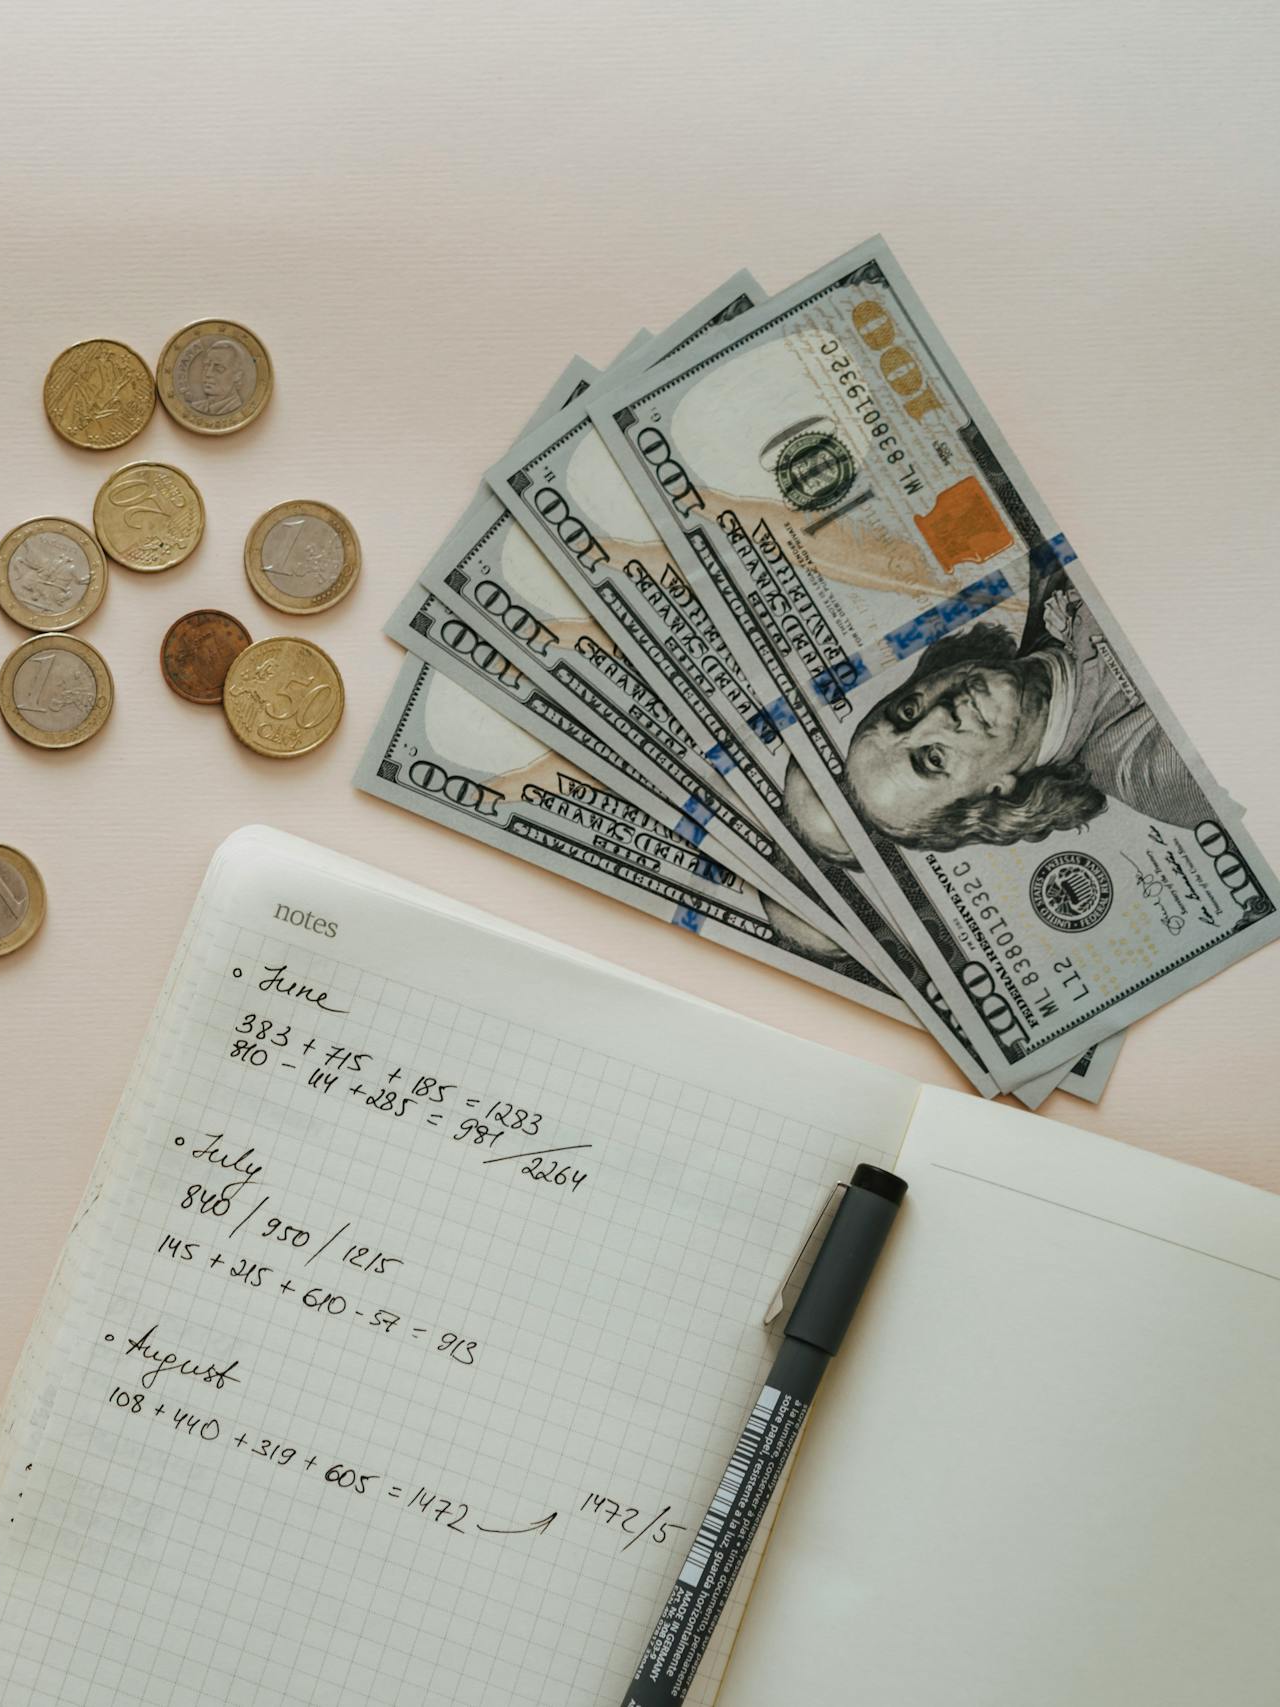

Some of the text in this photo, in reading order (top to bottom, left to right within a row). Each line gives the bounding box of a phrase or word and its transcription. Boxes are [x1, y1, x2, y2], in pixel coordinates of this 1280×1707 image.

[848, 297, 939, 421] 100
[831, 356, 904, 464] 83801932
[636, 426, 706, 519] 100
[533, 486, 611, 574] 100
[473, 579, 560, 658] 100
[690, 534, 754, 631] DOLLARS
[716, 509, 853, 721] UNITED STATES
[748, 520, 835, 651] AMERICA
[599, 586, 676, 676] DOLLARS
[749, 630, 816, 732] HUNDRED
[1100, 646, 1132, 695] FRANKLIN
[408, 759, 506, 817] 100
[511, 820, 609, 870] DOLLARS
[1192, 817, 1261, 910] 100
[273, 903, 339, 938] notes
[610, 862, 725, 920] HUNDRED
[926, 853, 1038, 1029] FEDERAL RESERVE NOTE
[963, 877, 1038, 987] 83801932
[258, 964, 347, 1014] June
[960, 958, 1029, 1051] 100
[230, 1039, 268, 1066] 810
[365, 1088, 418, 1117] 285
[453, 1118, 505, 1148] 981
[234, 1013, 543, 1136] 383 715 185 1283
[188, 1133, 268, 1212] July
[521, 1152, 588, 1193] 2264
[180, 1184, 404, 1274] 840 950 1215
[157, 1234, 478, 1365] 145 215 610 57 913
[125, 1324, 241, 1390] August
[774, 1394, 793, 1423] sobre
[789, 1408, 799, 1418] la
[108, 1386, 469, 1534] 108 440 319 605 1472
[737, 1458, 766, 1508] resistente
[749, 1461, 776, 1509] conserver
[729, 1518, 739, 1529] la
[735, 1518, 751, 1539] plat
[701, 1551, 726, 1589] guarda
[722, 1549, 739, 1573] tinta
[664, 1592, 710, 1677] horizontalmente
[670, 1621, 679, 1631] IN
[674, 1590, 693, 1620] MADE
[696, 1574, 729, 1634] documento,
[648, 1633, 675, 1682] GERMANY
[668, 1635, 702, 1696] permanente
